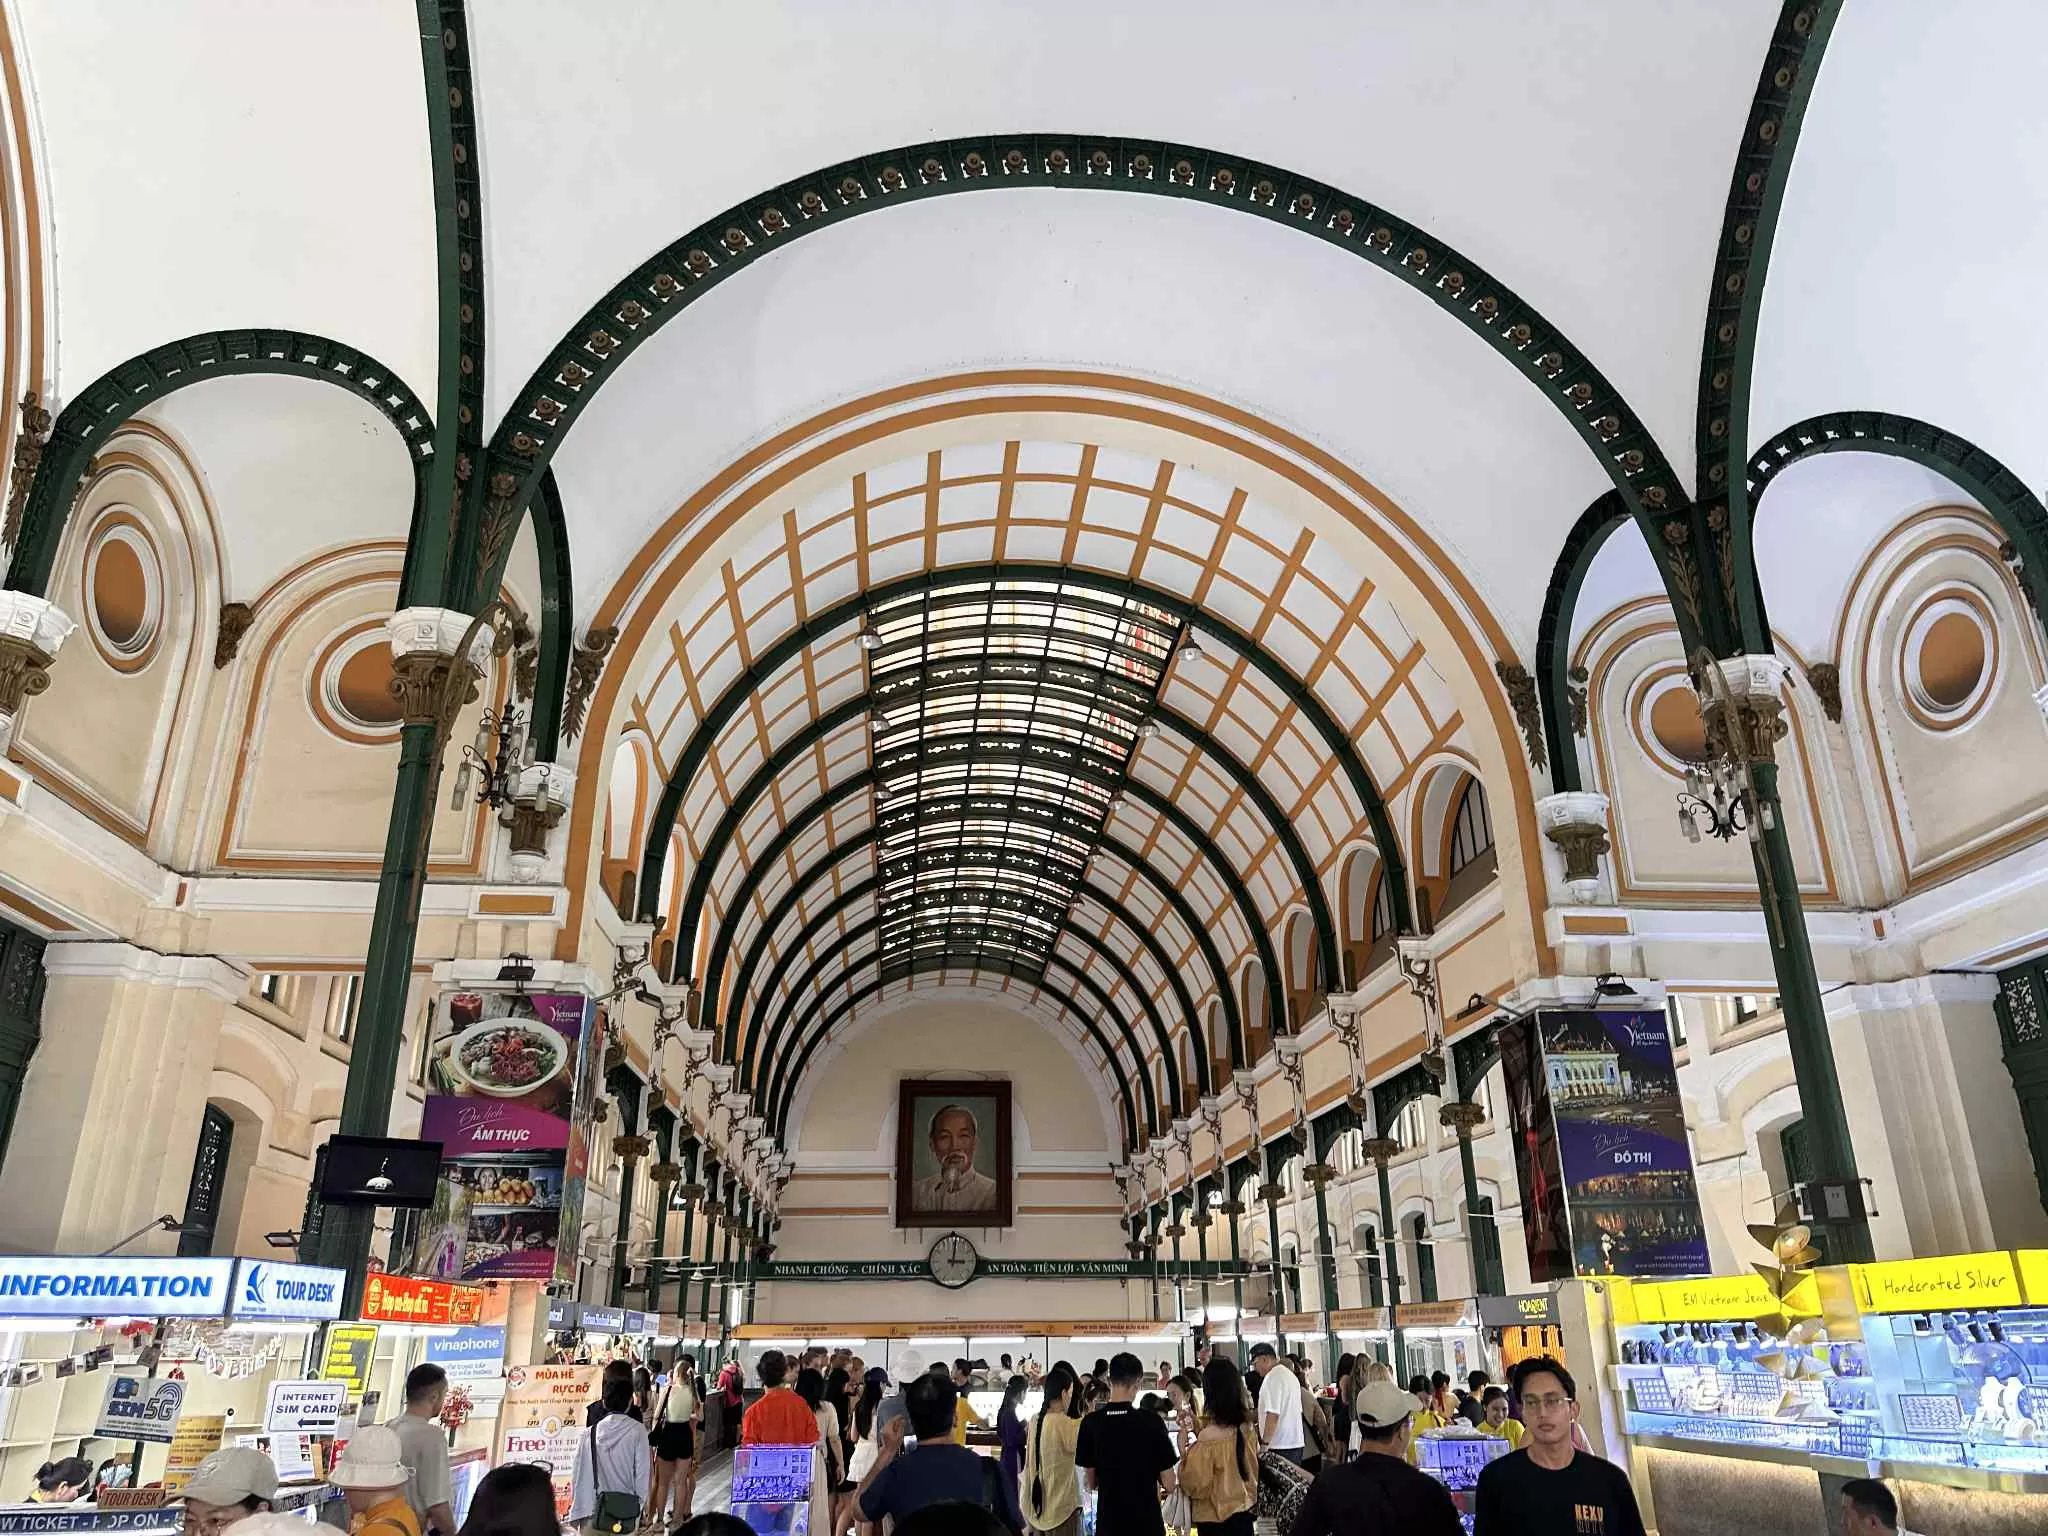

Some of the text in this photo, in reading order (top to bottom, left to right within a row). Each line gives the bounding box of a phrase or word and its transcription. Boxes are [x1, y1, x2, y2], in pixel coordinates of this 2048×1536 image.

[1623, 1025, 1665, 1047] Vietnam
[495, 1128, 531, 1144] THỰC
[1614, 1150, 1652, 1166] ĐÔ THỊ
[775, 1265, 810, 1274] NHANH
[813, 1263, 849, 1274] CHÓNG
[861, 1263, 896, 1274] CHÍNH
[900, 1263, 921, 1274] XÁC
[987, 1264, 1000, 1273] AN
[1001, 1261, 1026, 1273] TOÀN
[1034, 1261, 1057, 1275] TIỆN
[1058, 1263, 1075, 1274] LỢI
[1081, 1262, 1101, 1273] VĂN
[1102, 1264, 1129, 1273] MINH
[0, 1275, 213, 1297] INFORMATION
[1966, 1271, 2006, 1290] Silver
[276, 1280, 336, 1303] TOUR DESK
[434, 1337, 501, 1352] vinaphone
[535, 1368, 559, 1380] MÙA
[282, 1393, 337, 1401] INTERNET
[553, 1384, 574, 1396] RỰC
[107, 1398, 175, 1421] SIM 5G
[276, 1404, 337, 1414] SIM CARD
[507, 1436, 546, 1453] Free
[104, 1491, 160, 1507] TOUR DESK
[20, 1516, 79, 1531] TICKET
[133, 1513, 159, 1527] ON
